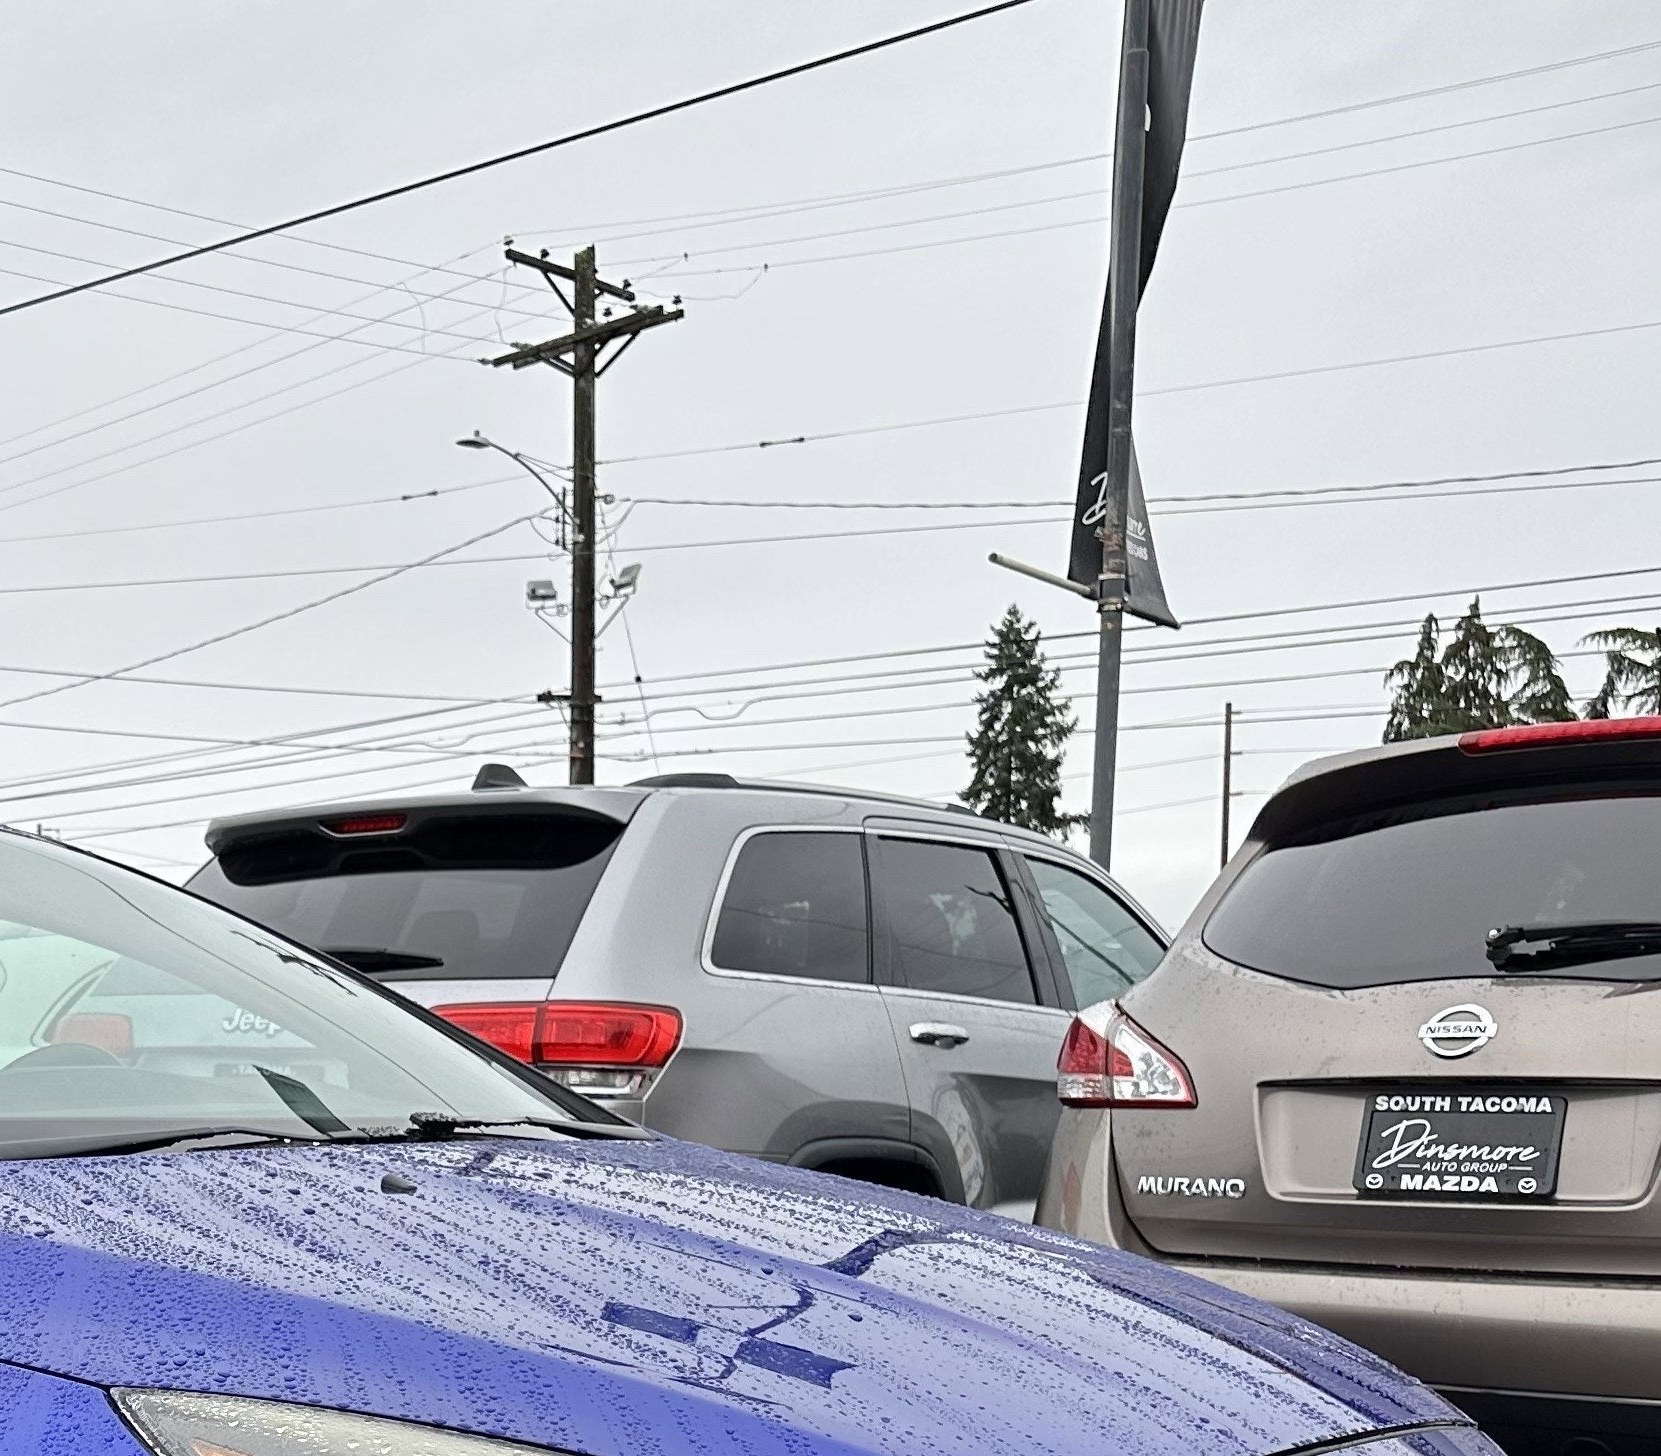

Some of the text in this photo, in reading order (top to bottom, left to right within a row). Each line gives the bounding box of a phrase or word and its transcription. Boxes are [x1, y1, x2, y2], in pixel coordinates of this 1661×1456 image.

[1426, 1025, 1487, 1034] NISSAN
[1375, 1095, 1552, 1113] SOUTH TACOMA
[1372, 1118, 1540, 1168] Dinsmore
[1422, 1161, 1508, 1174] AUTO GROUP
[1137, 1175, 1246, 1199] MURANO
[1400, 1173, 1499, 1193] MAZDA
